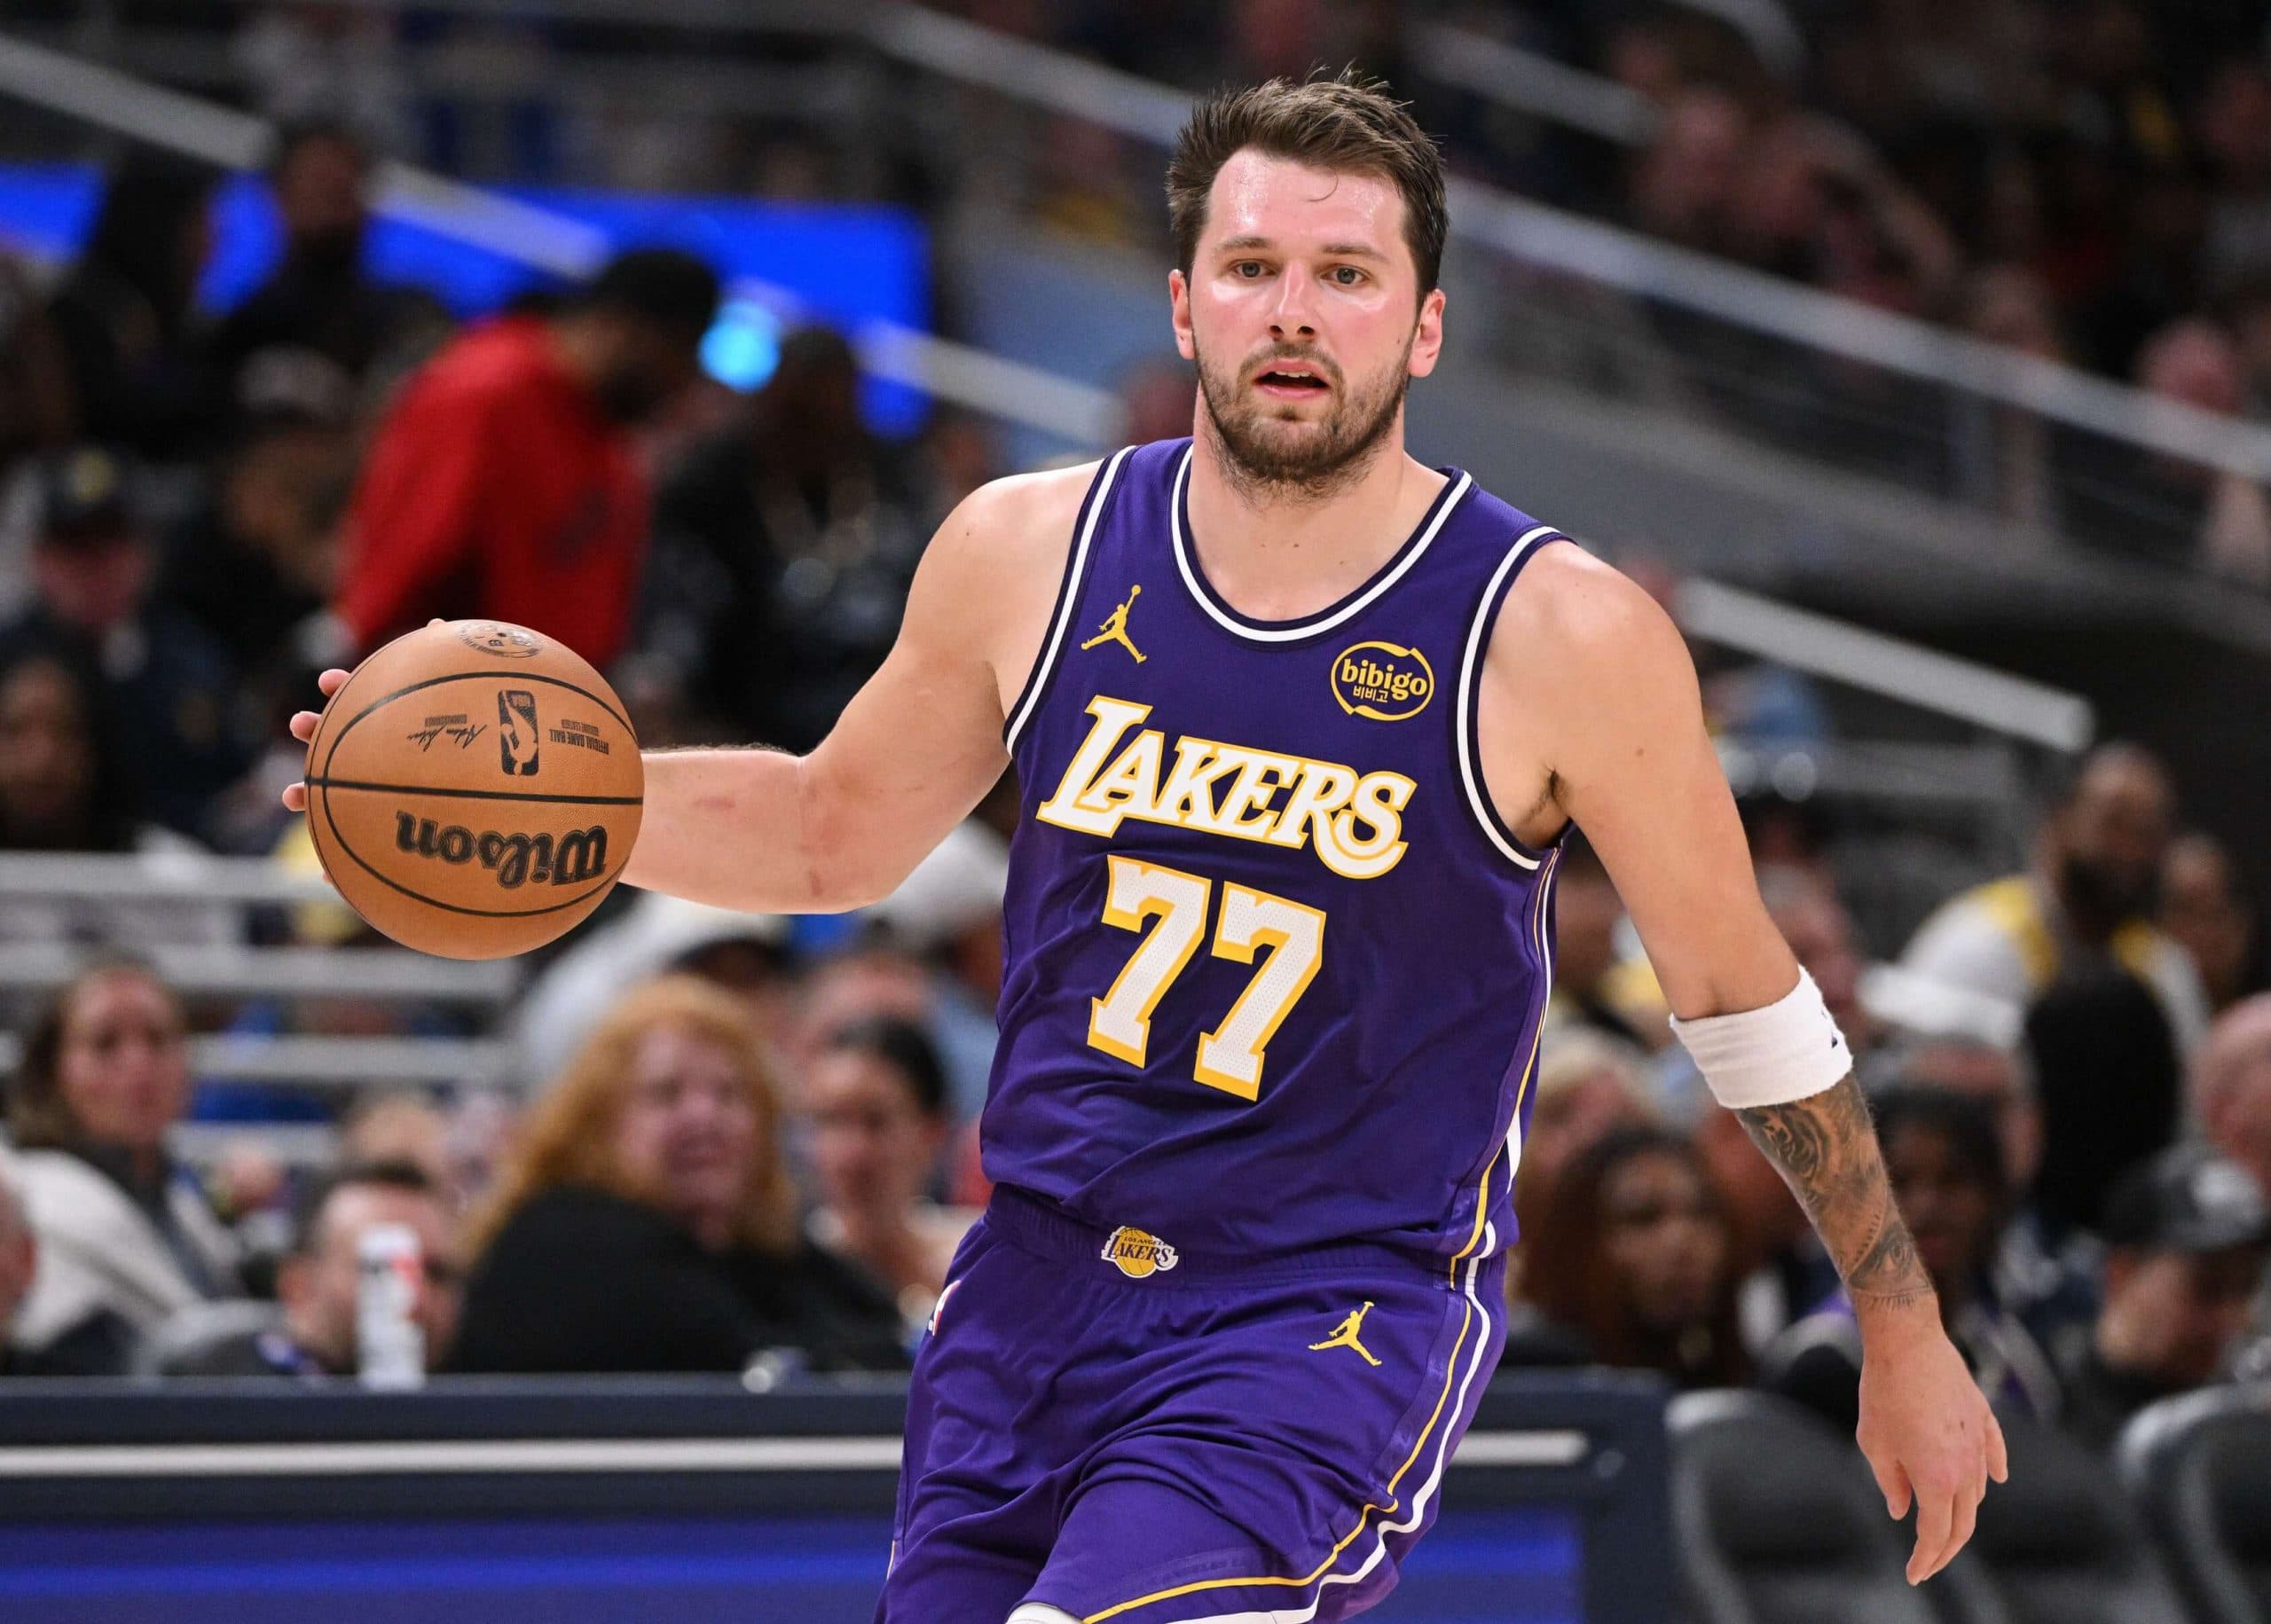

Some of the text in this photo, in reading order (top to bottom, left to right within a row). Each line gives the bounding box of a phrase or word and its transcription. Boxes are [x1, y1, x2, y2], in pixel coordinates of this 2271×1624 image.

[1341, 658, 1427, 701] bibigo
[1353, 685, 1390, 703] 비비고
[1035, 694, 1418, 879] LAKERS
[396, 809, 609, 889] Wilson
[1087, 853, 1327, 1102] 77
[1106, 1234, 1173, 1268] LAKERS
